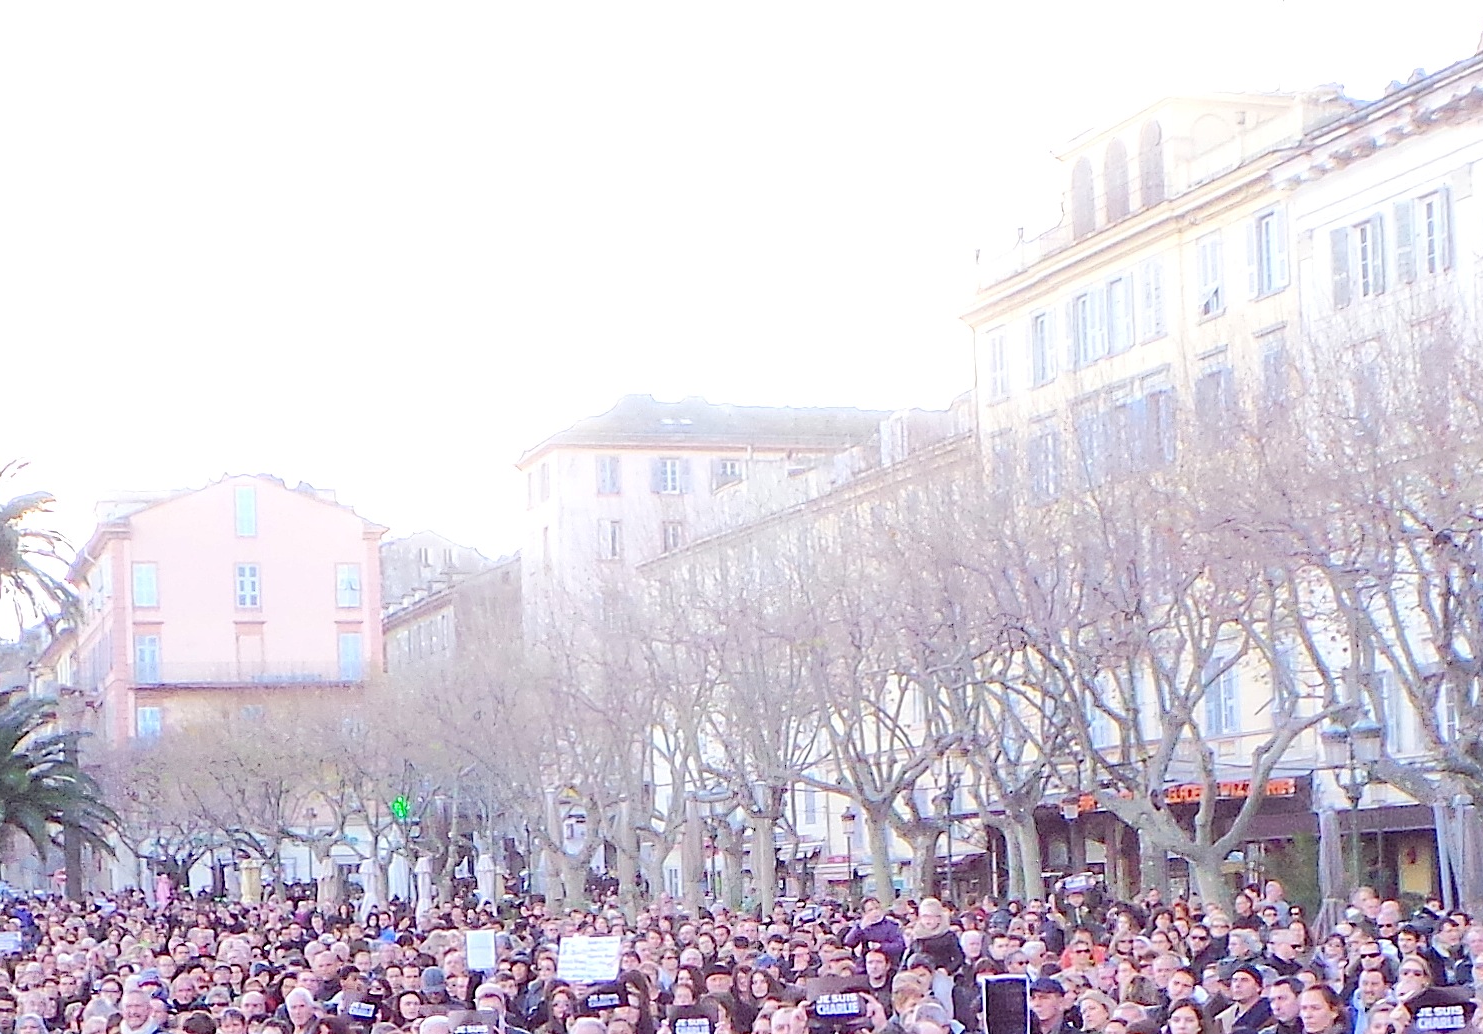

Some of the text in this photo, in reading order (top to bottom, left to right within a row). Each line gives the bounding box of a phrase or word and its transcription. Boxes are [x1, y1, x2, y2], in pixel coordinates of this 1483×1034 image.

[817, 993, 858, 1004] JE SUIS
[816, 1002, 860, 1015] CHARLIE
[1417, 1006, 1464, 1017] JE SUIS
[675, 1018, 709, 1027] JE SUIS
[1418, 1015, 1465, 1029] CHARLIE
